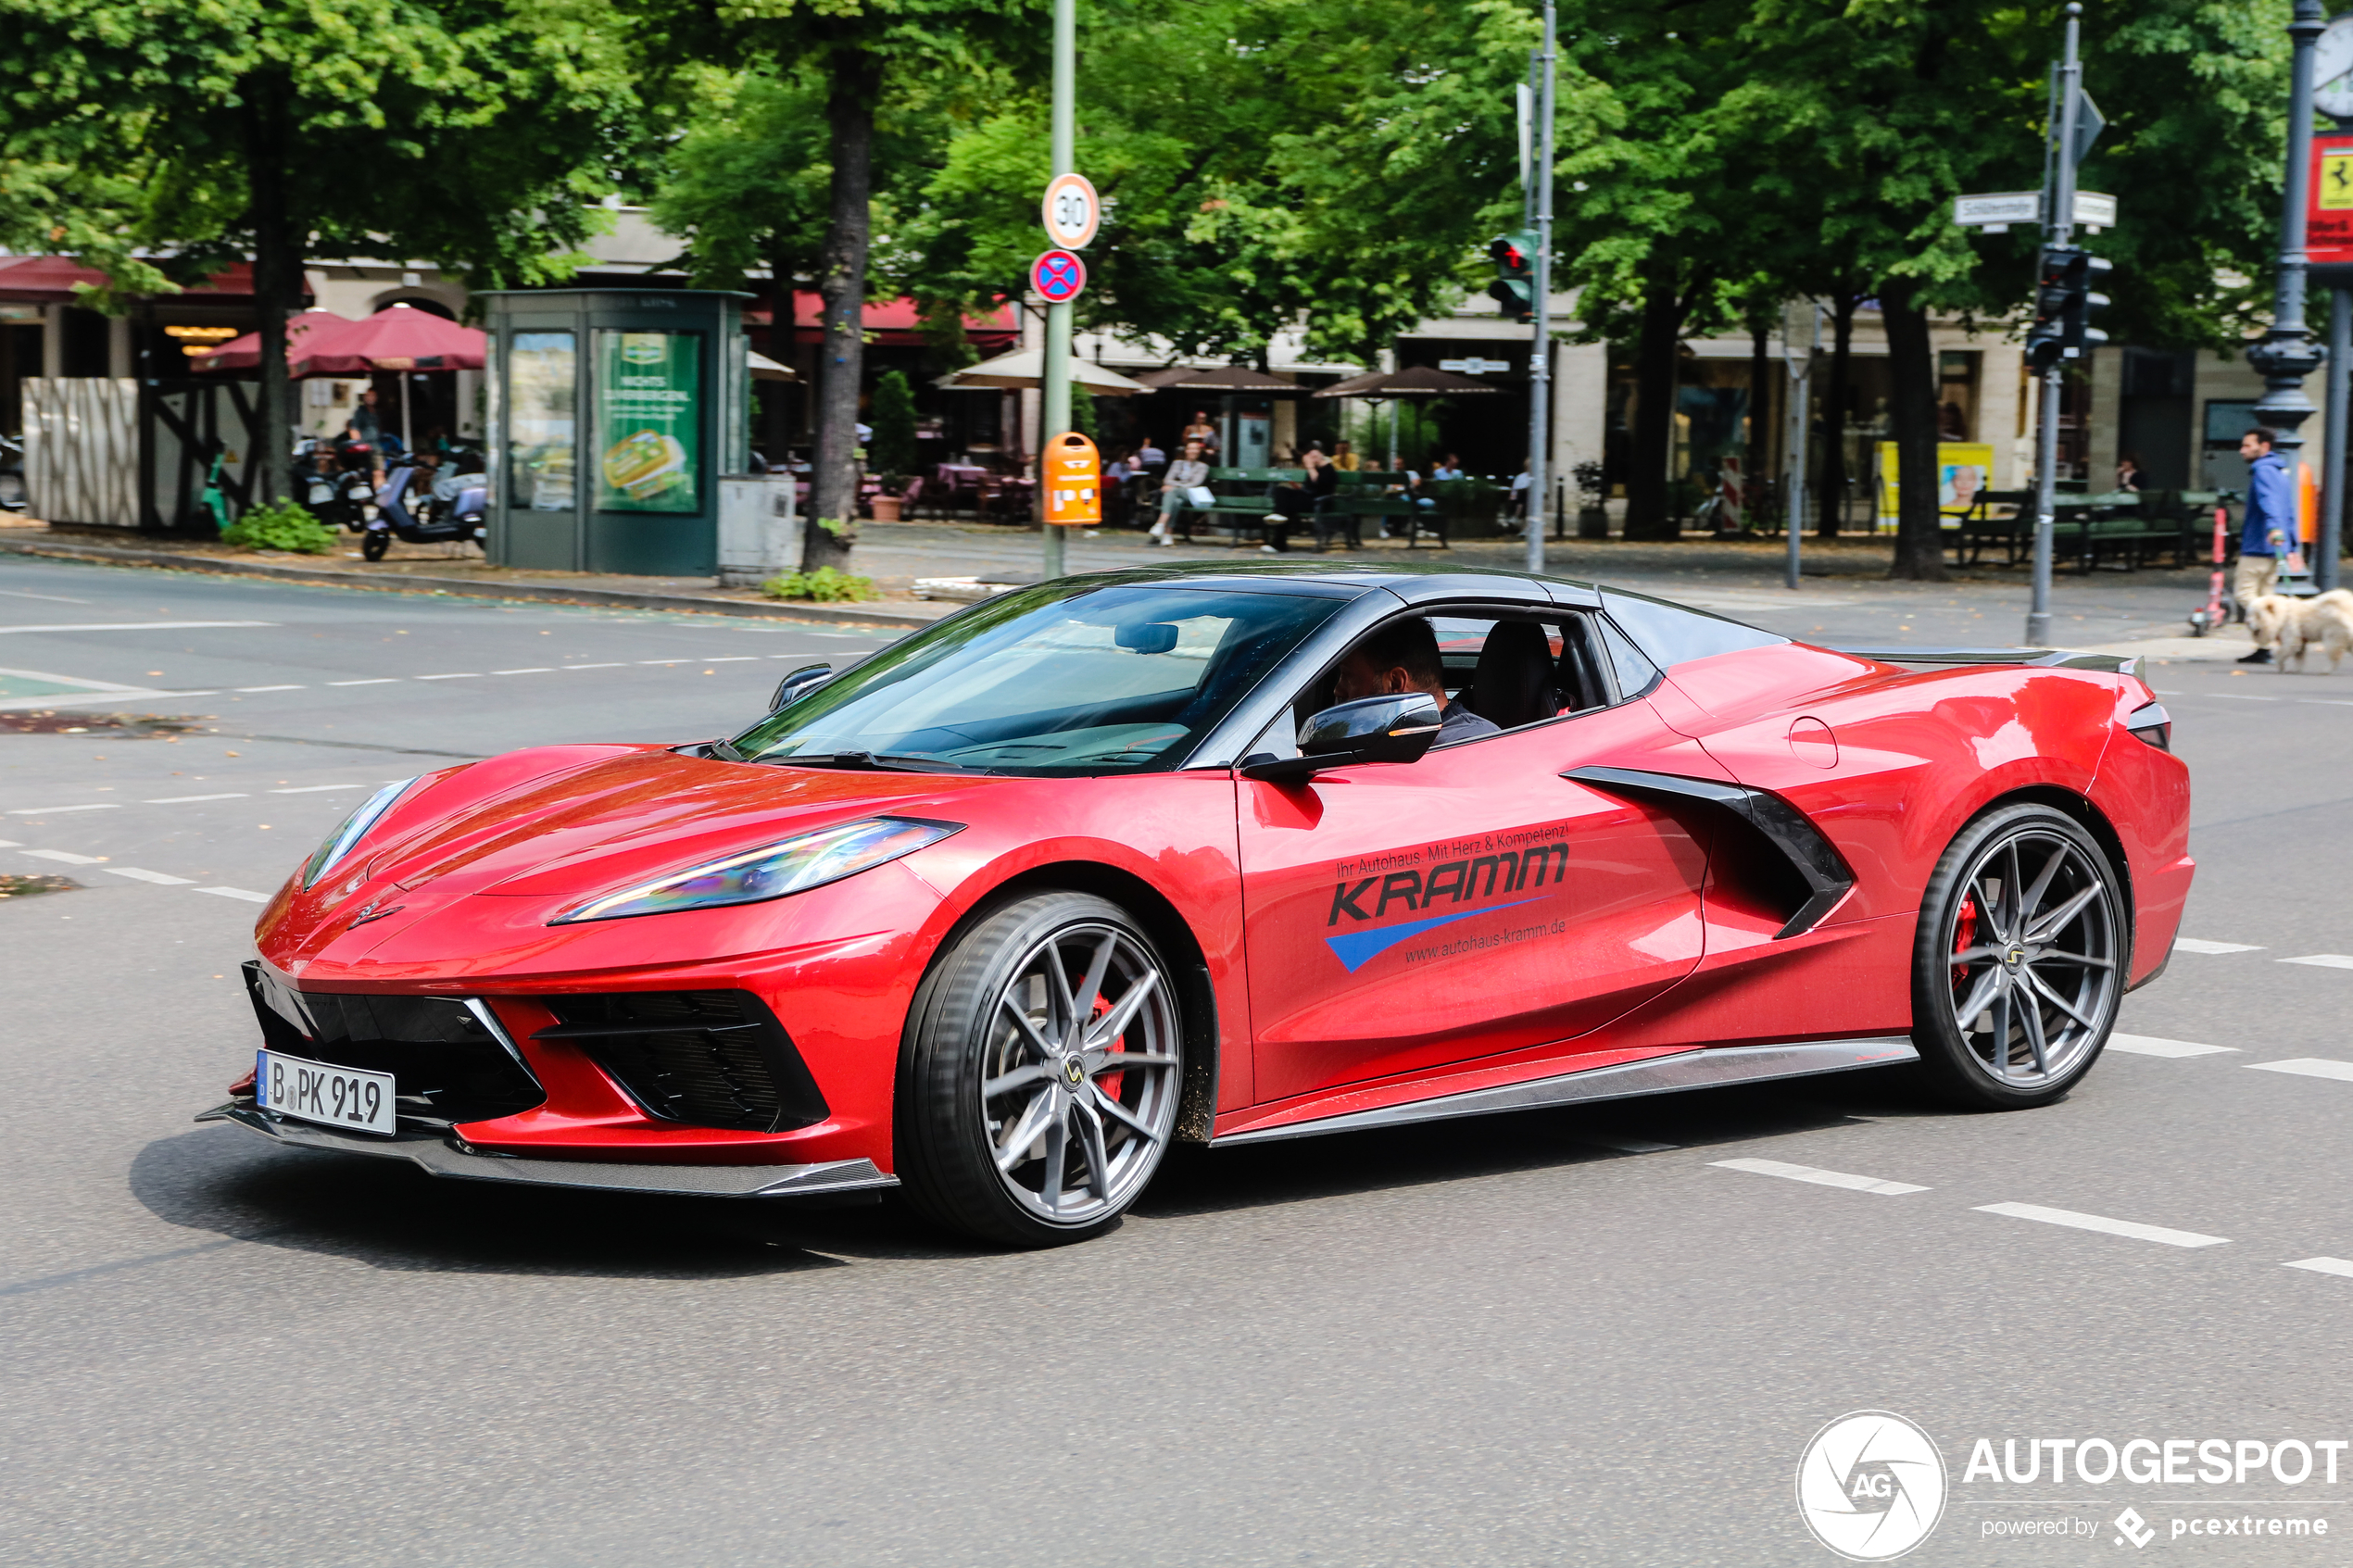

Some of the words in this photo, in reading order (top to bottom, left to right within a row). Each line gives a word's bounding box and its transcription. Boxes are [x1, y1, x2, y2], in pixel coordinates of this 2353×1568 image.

[1056, 195, 1085, 227] 30
[1337, 860, 1354, 878] Ihr
[1358, 851, 1424, 874] Autohaus.
[1428, 843, 1448, 861] Mit
[1453, 839, 1480, 857] Herz
[1485, 836, 1494, 851] &
[1497, 822, 1569, 849] Kompetenz!
[1327, 842, 1568, 926] KRAMM
[1405, 918, 1566, 963] www.autohaus-kramm.de
[259, 1084, 265, 1096] D
[273, 1061, 284, 1104] B
[298, 1068, 325, 1115] PK
[332, 1075, 381, 1123] 919
